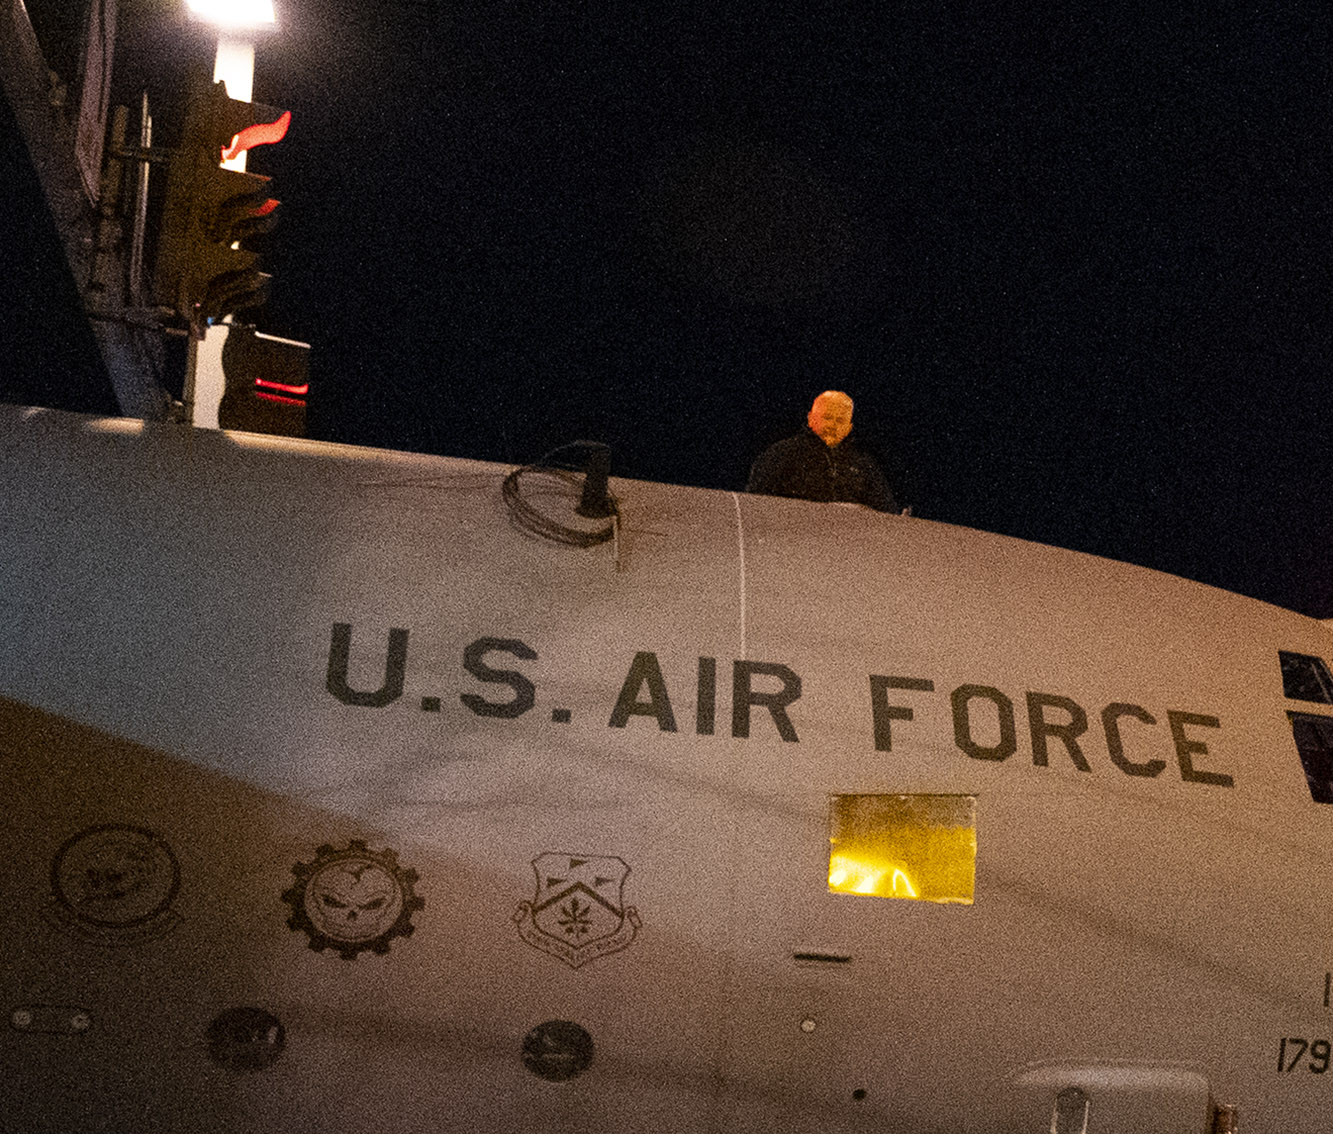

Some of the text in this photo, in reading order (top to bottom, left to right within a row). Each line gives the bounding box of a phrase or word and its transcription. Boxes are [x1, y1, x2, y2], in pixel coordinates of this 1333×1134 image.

[325, 622, 1234, 790] U.S. AIR FORCE
[1277, 1037, 1332, 1075] 179
